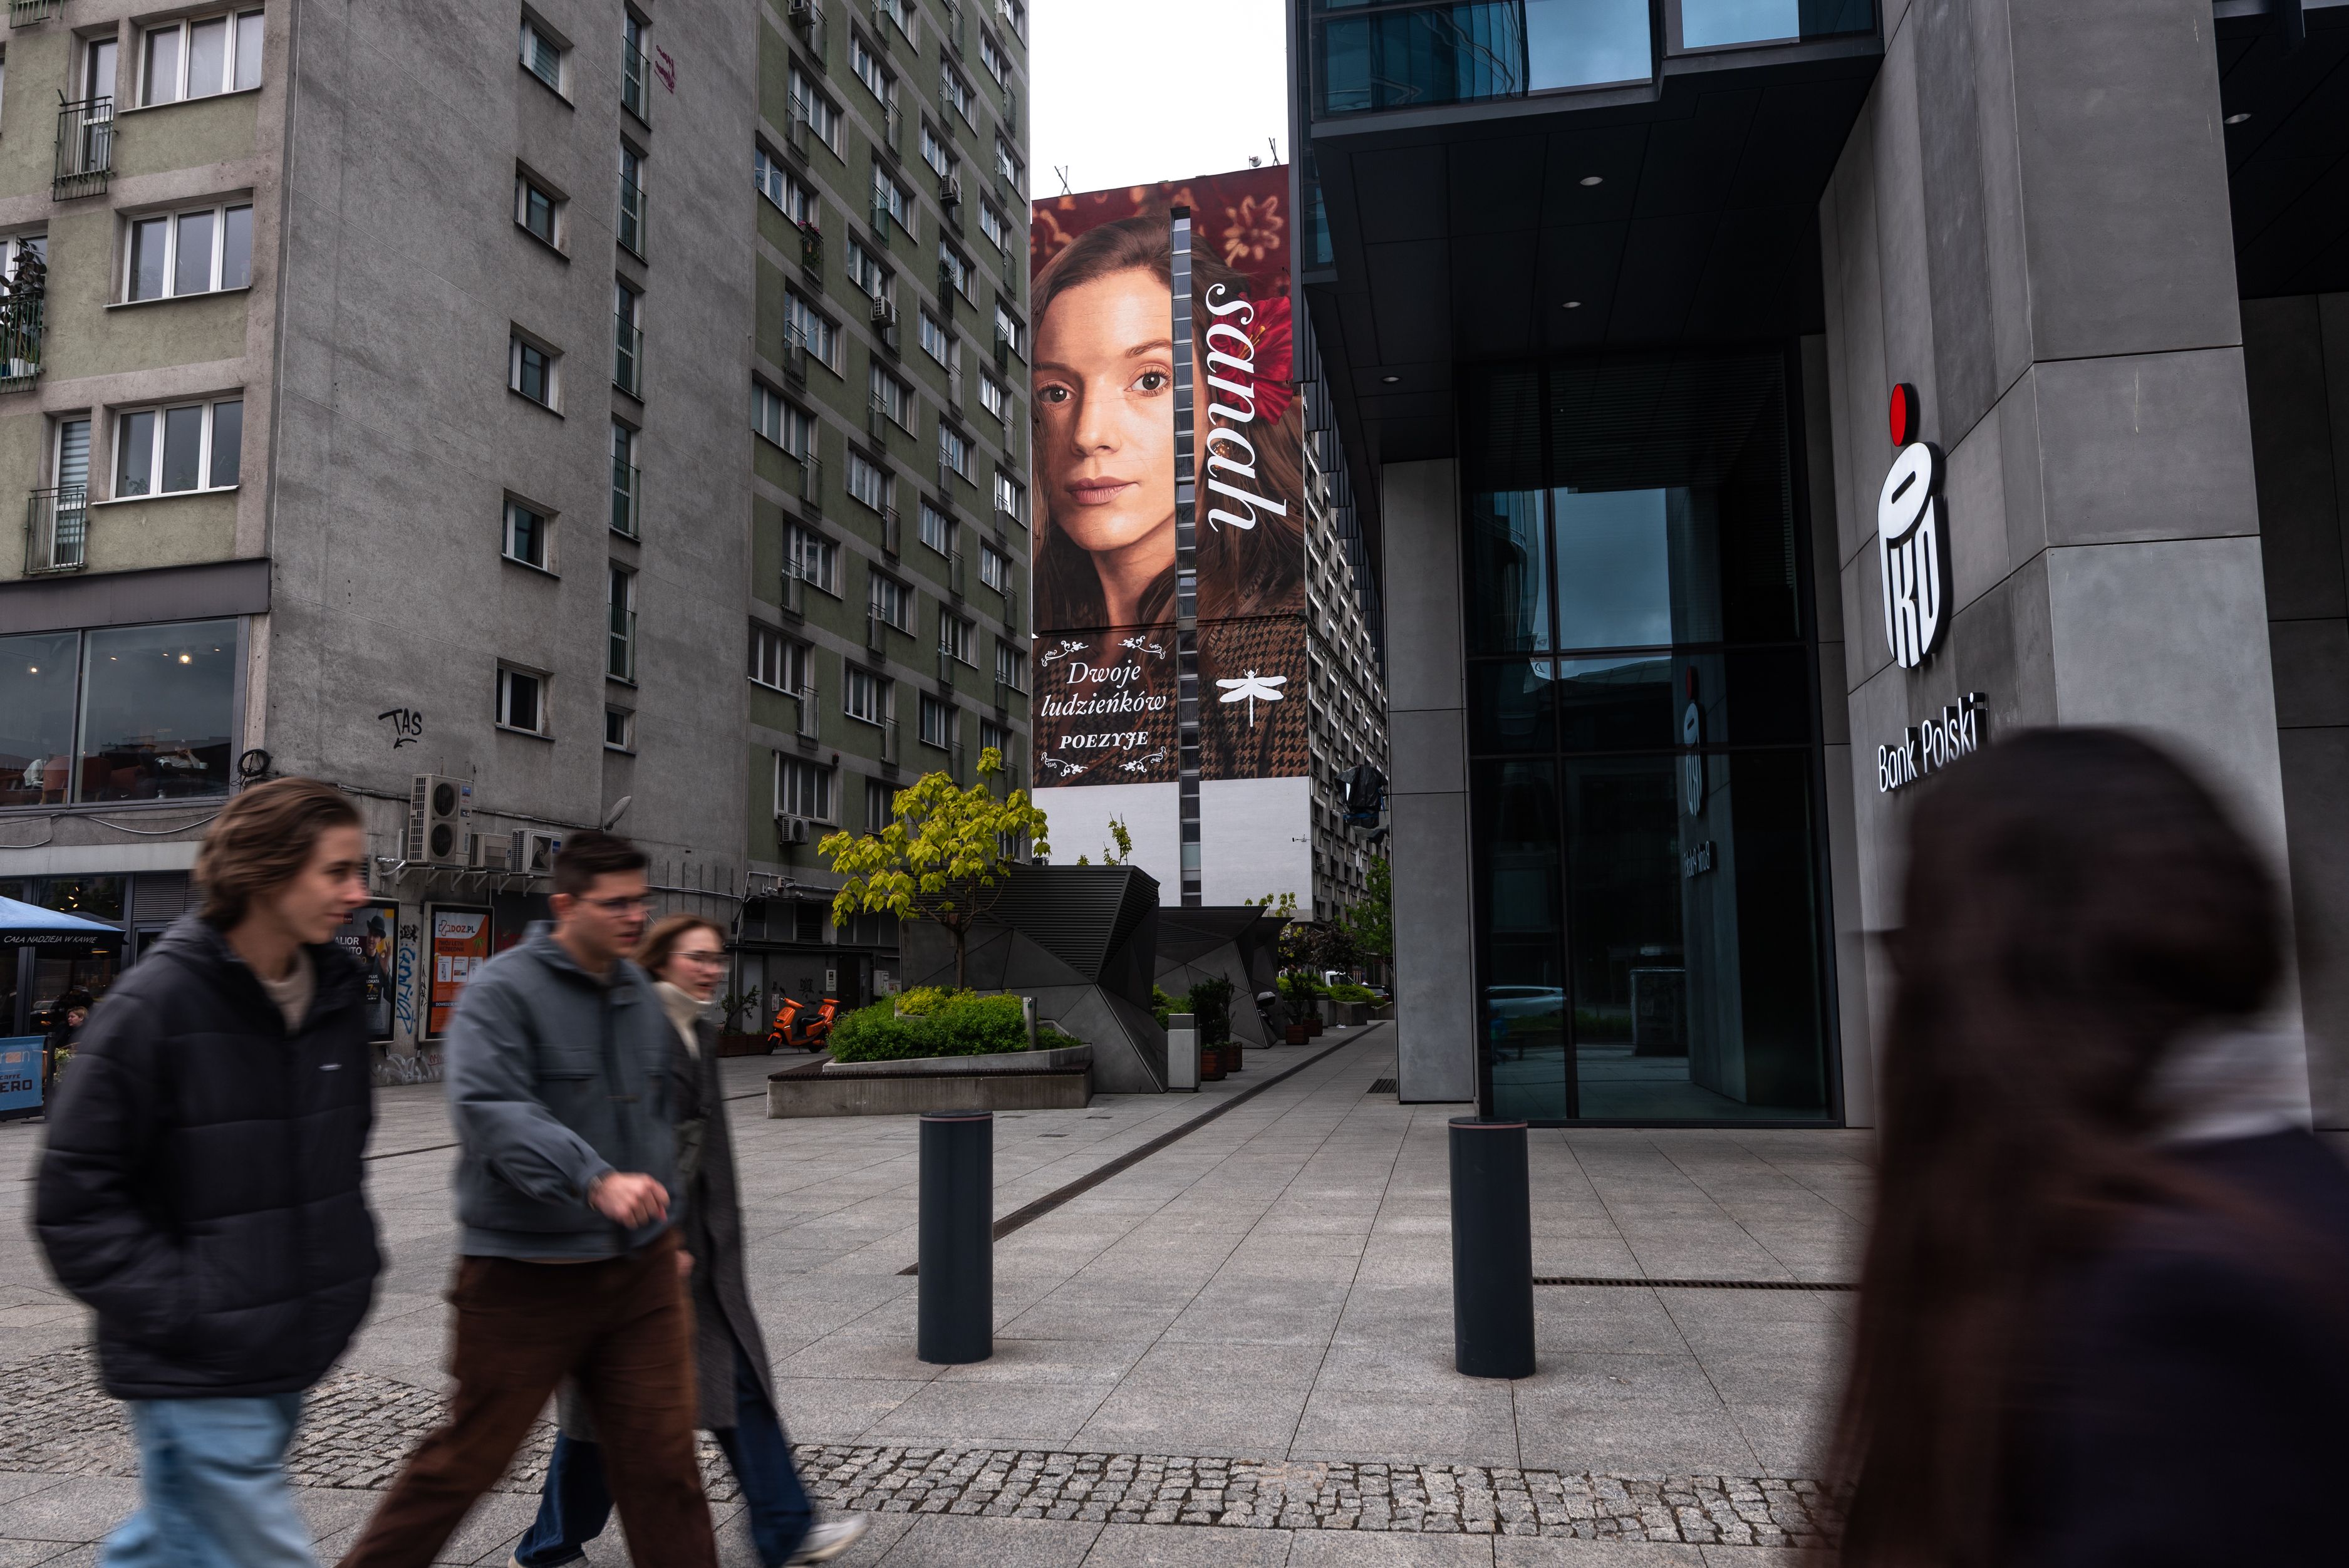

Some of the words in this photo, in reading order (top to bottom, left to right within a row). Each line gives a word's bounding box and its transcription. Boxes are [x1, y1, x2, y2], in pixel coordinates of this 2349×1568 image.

[1206, 283, 1287, 532] sanah
[1878, 442, 1942, 669] PKO
[1066, 659, 1141, 688] Dwoje
[1040, 690, 1166, 717] ludzieńków
[378, 708, 422, 736] TAS
[1059, 732, 1148, 750] POEZYJE
[1879, 727, 1917, 792] Bank
[1922, 692, 1977, 773] Polski
[334, 937, 359, 945] ALIOR
[451, 925, 475, 933] DOZ.PL
